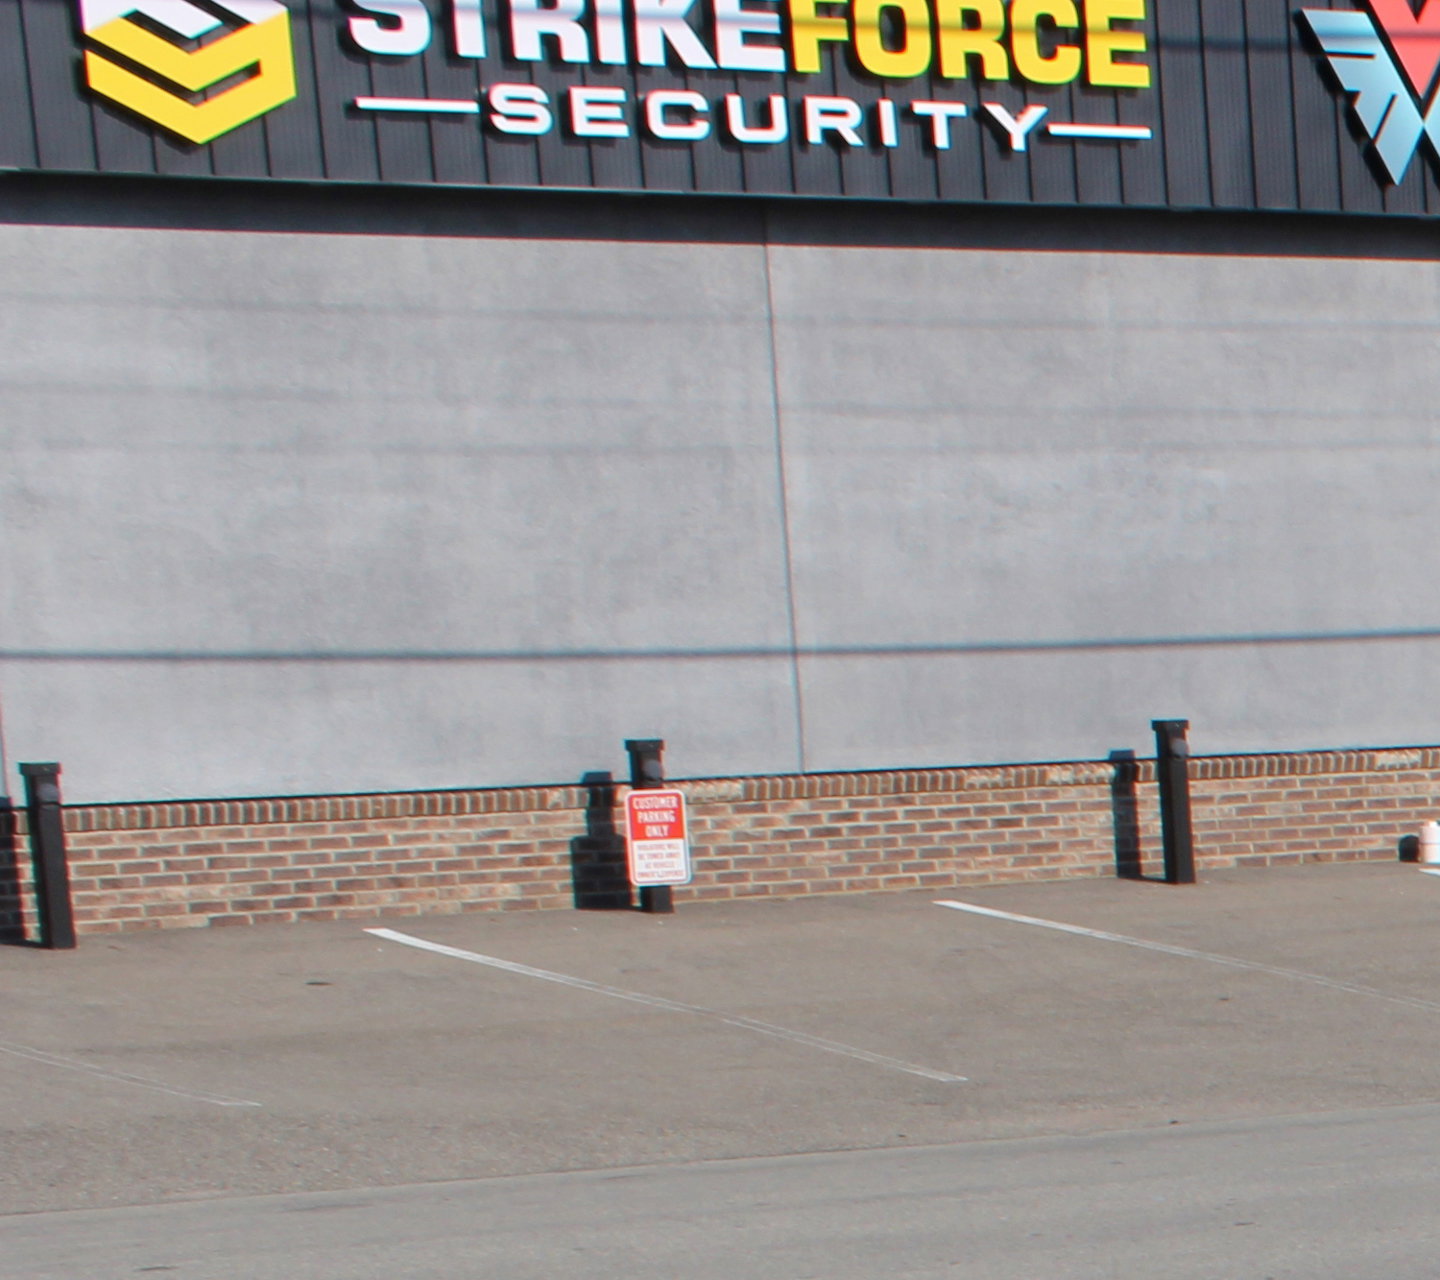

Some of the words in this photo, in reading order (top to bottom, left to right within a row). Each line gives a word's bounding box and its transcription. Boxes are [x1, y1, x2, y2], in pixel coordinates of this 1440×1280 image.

[347, 0, 1151, 88] STRIKEFORCE
[489, 82, 1049, 151] SECURITY
[632, 796, 679, 811] CUSTOMER
[637, 811, 676, 825] PARKING
[645, 825, 670, 838] ONLY
